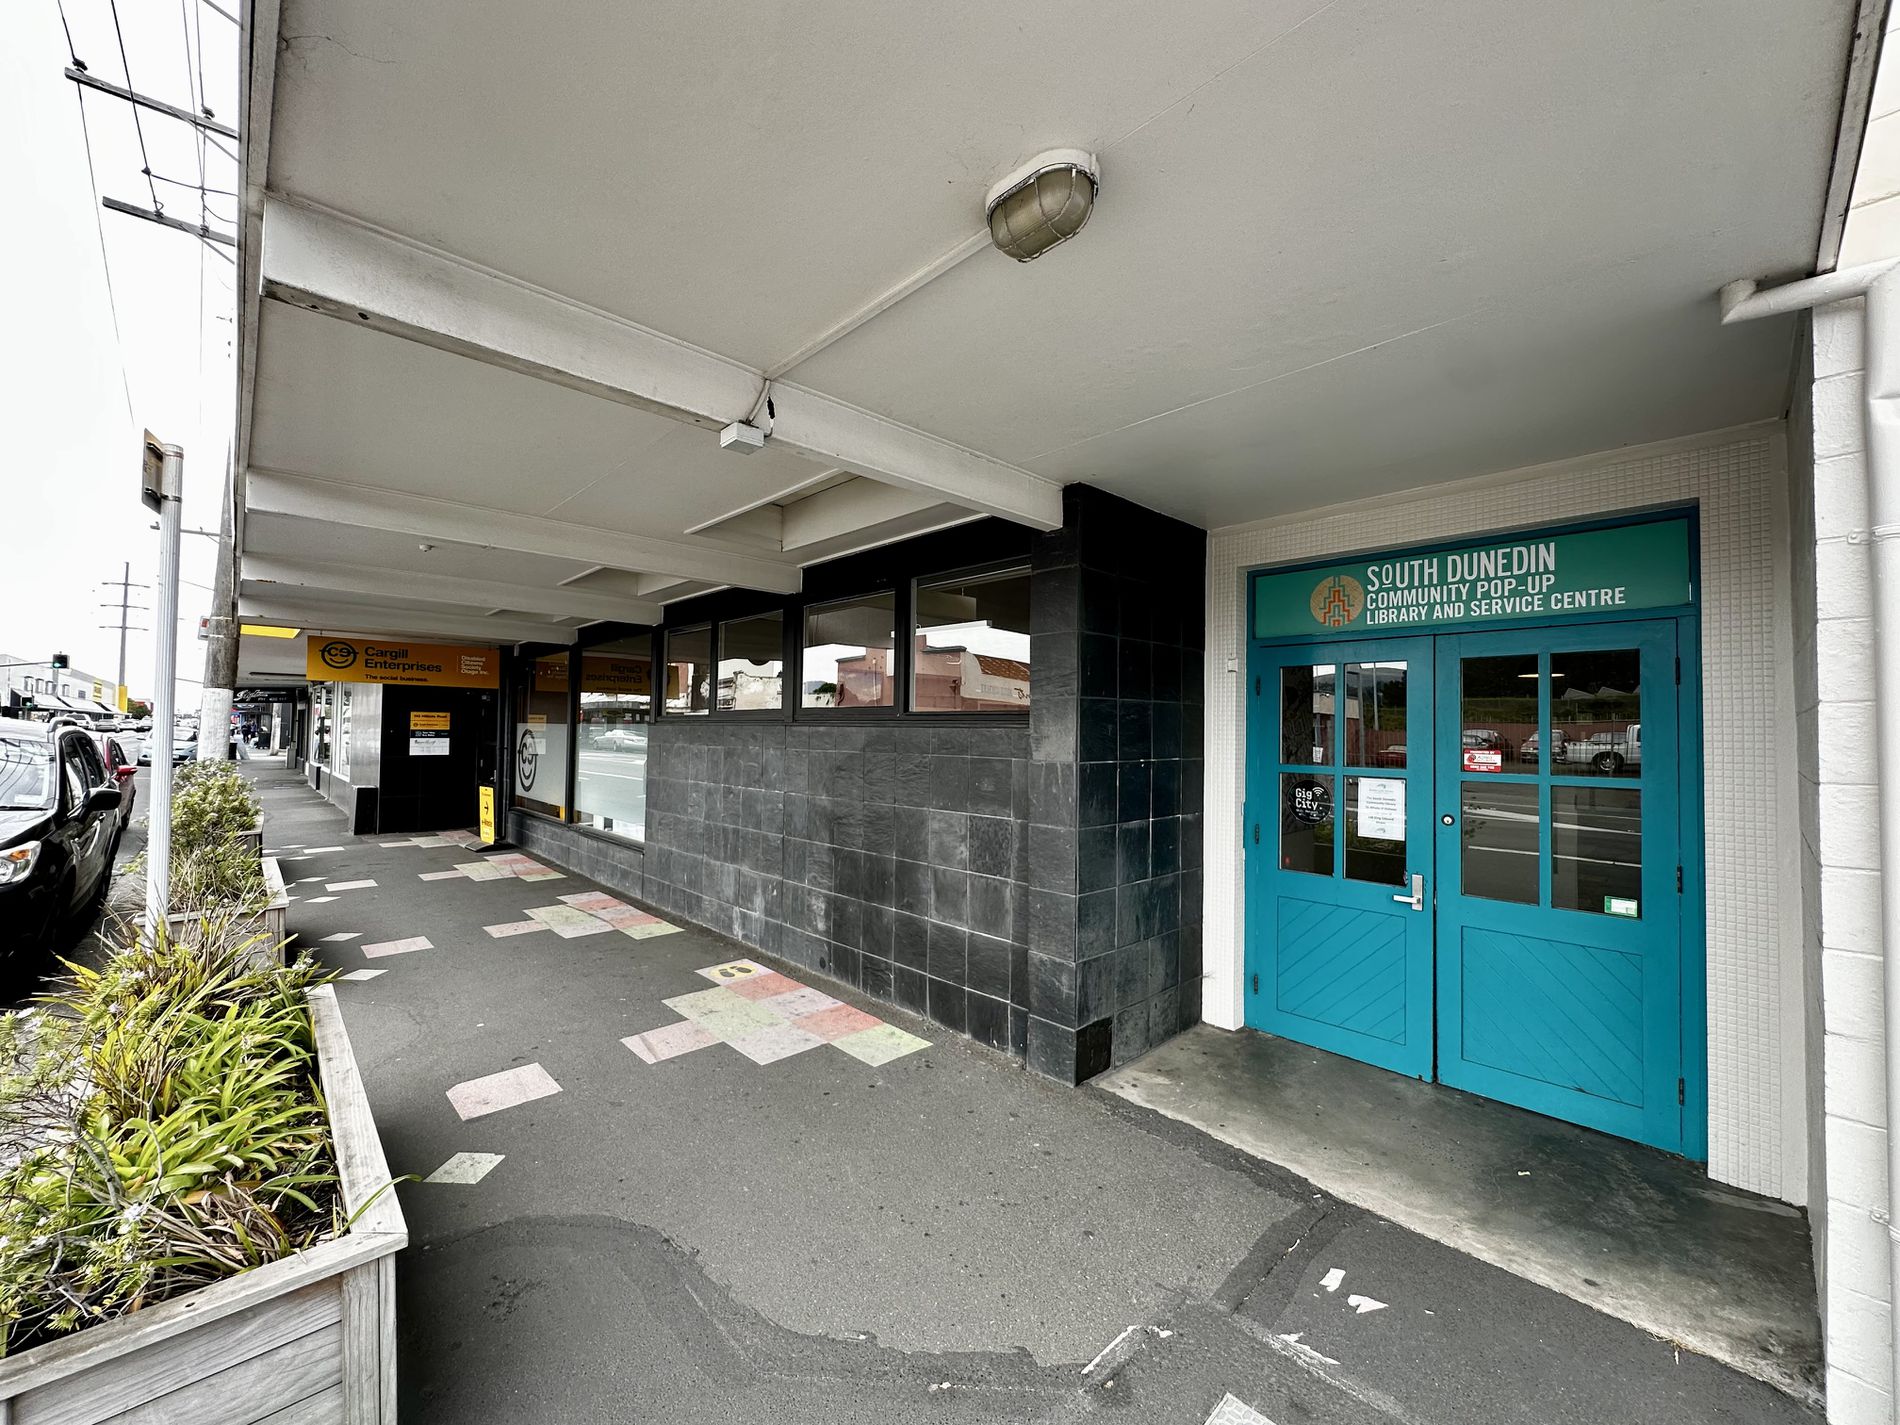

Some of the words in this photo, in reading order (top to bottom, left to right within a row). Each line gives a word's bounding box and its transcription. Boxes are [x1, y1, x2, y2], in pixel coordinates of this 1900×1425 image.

[1366, 557, 1438, 592] SOUTH
[1447, 541, 1556, 583] DUNEDIN
[1366, 582, 1470, 610] COMMUNITY
[1477, 573, 1556, 599] POP-UP
[1366, 603, 1430, 625] LIBRARY
[1433, 602, 1464, 620] AND
[1470, 594, 1544, 617] SERVICE
[1551, 586, 1626, 610] CENTRE
[364, 646, 409, 660] Cargill
[364, 658, 442, 673] Enterprises
[1295, 787, 1313, 800] Gig
[1295, 798, 1318, 811] City
